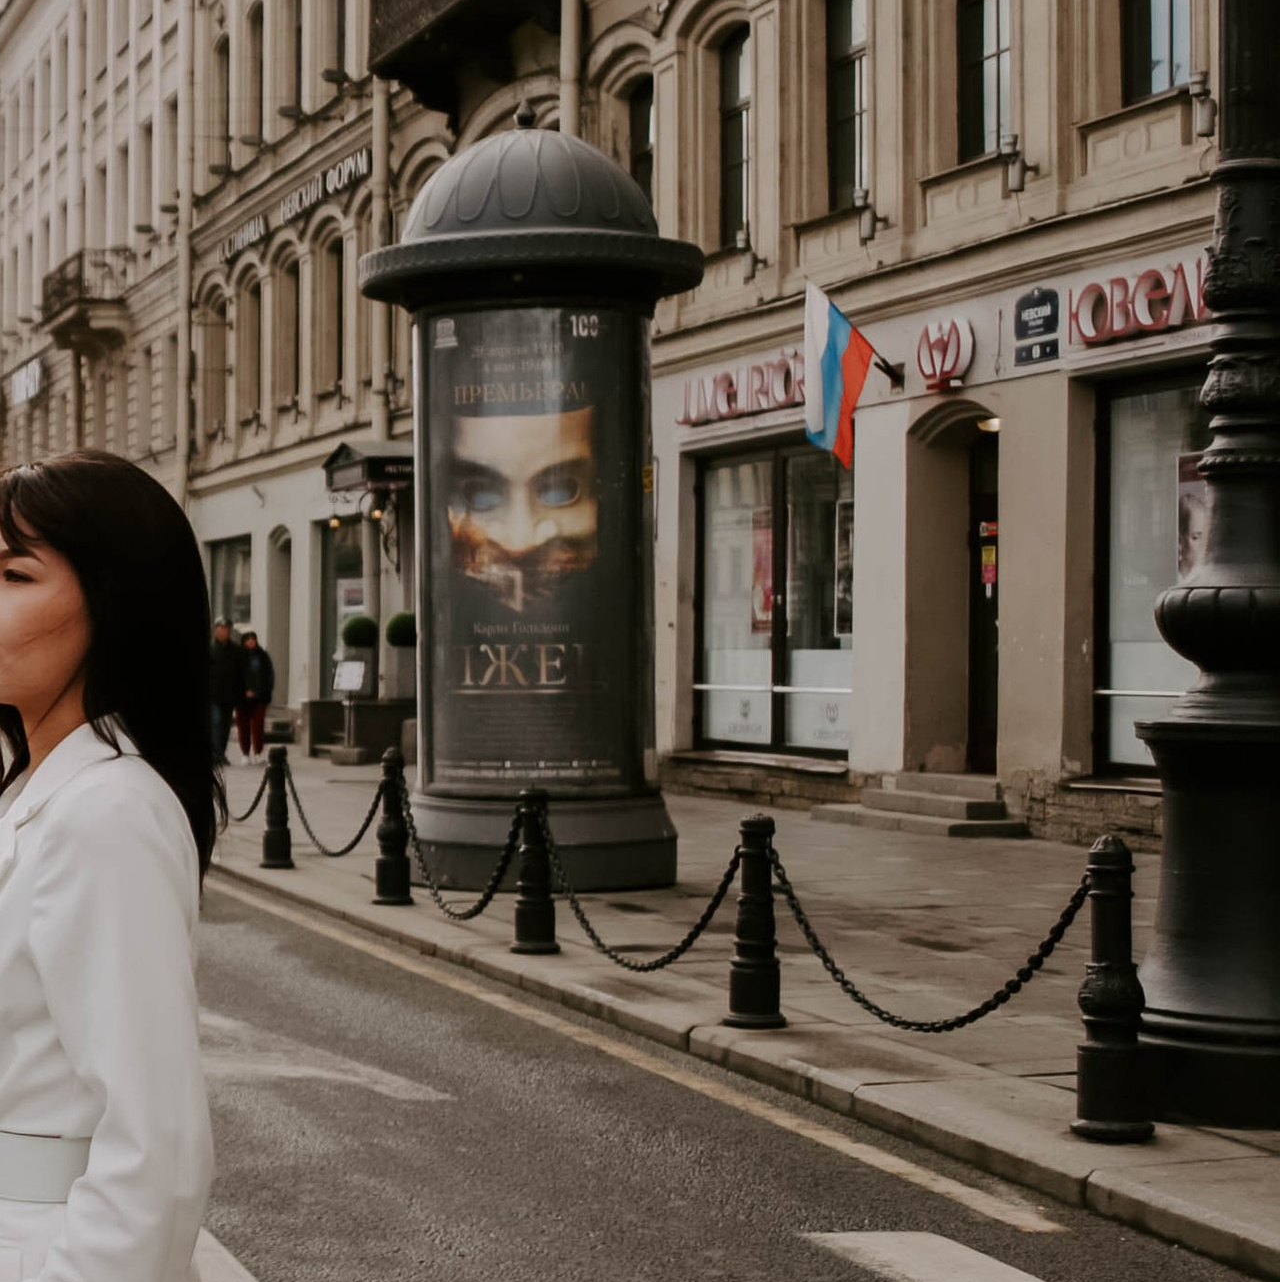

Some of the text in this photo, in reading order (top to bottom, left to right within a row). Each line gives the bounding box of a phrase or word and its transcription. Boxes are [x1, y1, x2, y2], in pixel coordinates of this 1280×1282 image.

[280, 172, 323, 225] НЕВСКИЙ
[326, 147, 369, 195] ФОРУМ
[1021, 302, 1052, 322] НЕВСКИЙ
[453, 381, 588, 405] ПРЕМЬЕРА!
